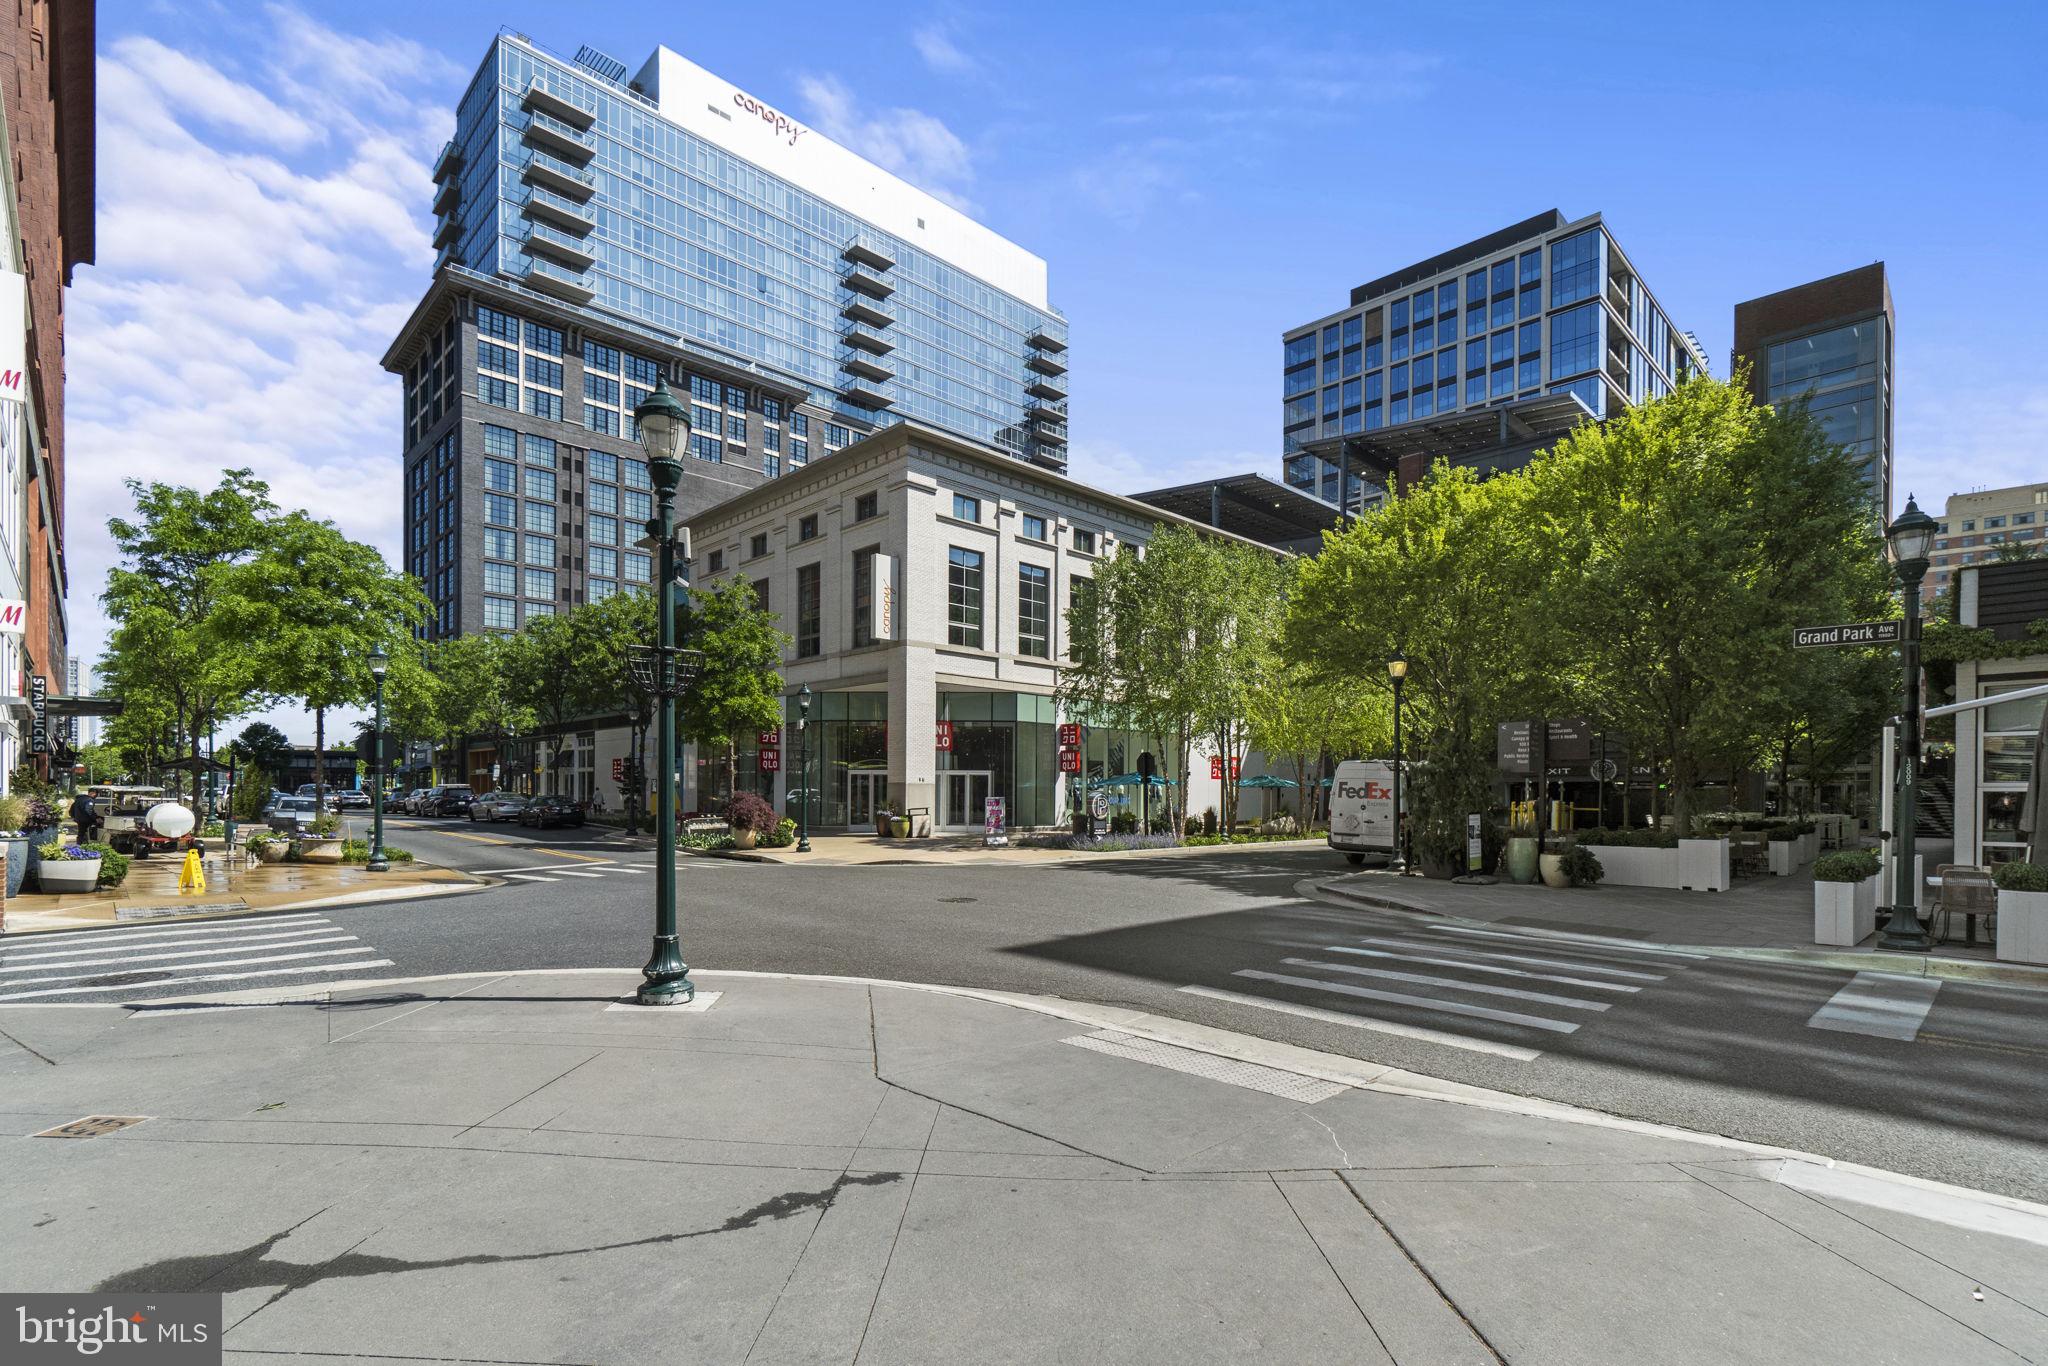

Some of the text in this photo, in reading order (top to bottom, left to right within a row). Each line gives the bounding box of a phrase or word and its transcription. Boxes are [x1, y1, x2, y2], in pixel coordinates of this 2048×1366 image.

[733, 93, 808, 146] canopy
[883, 578, 897, 634] canopy
[1799, 625, 1895, 644] Grand Park Ave
[33, 677, 45, 752] STARBUCKS
[935, 725, 948, 735] NI
[935, 737, 950, 748] LO
[762, 751, 777, 760] UNI
[1062, 752, 1076, 761] UNI
[762, 760, 778, 770] QLO
[1062, 762, 1076, 771] QLO
[1547, 767, 1572, 775] XIT
[1337, 781, 1392, 800] FedEx
